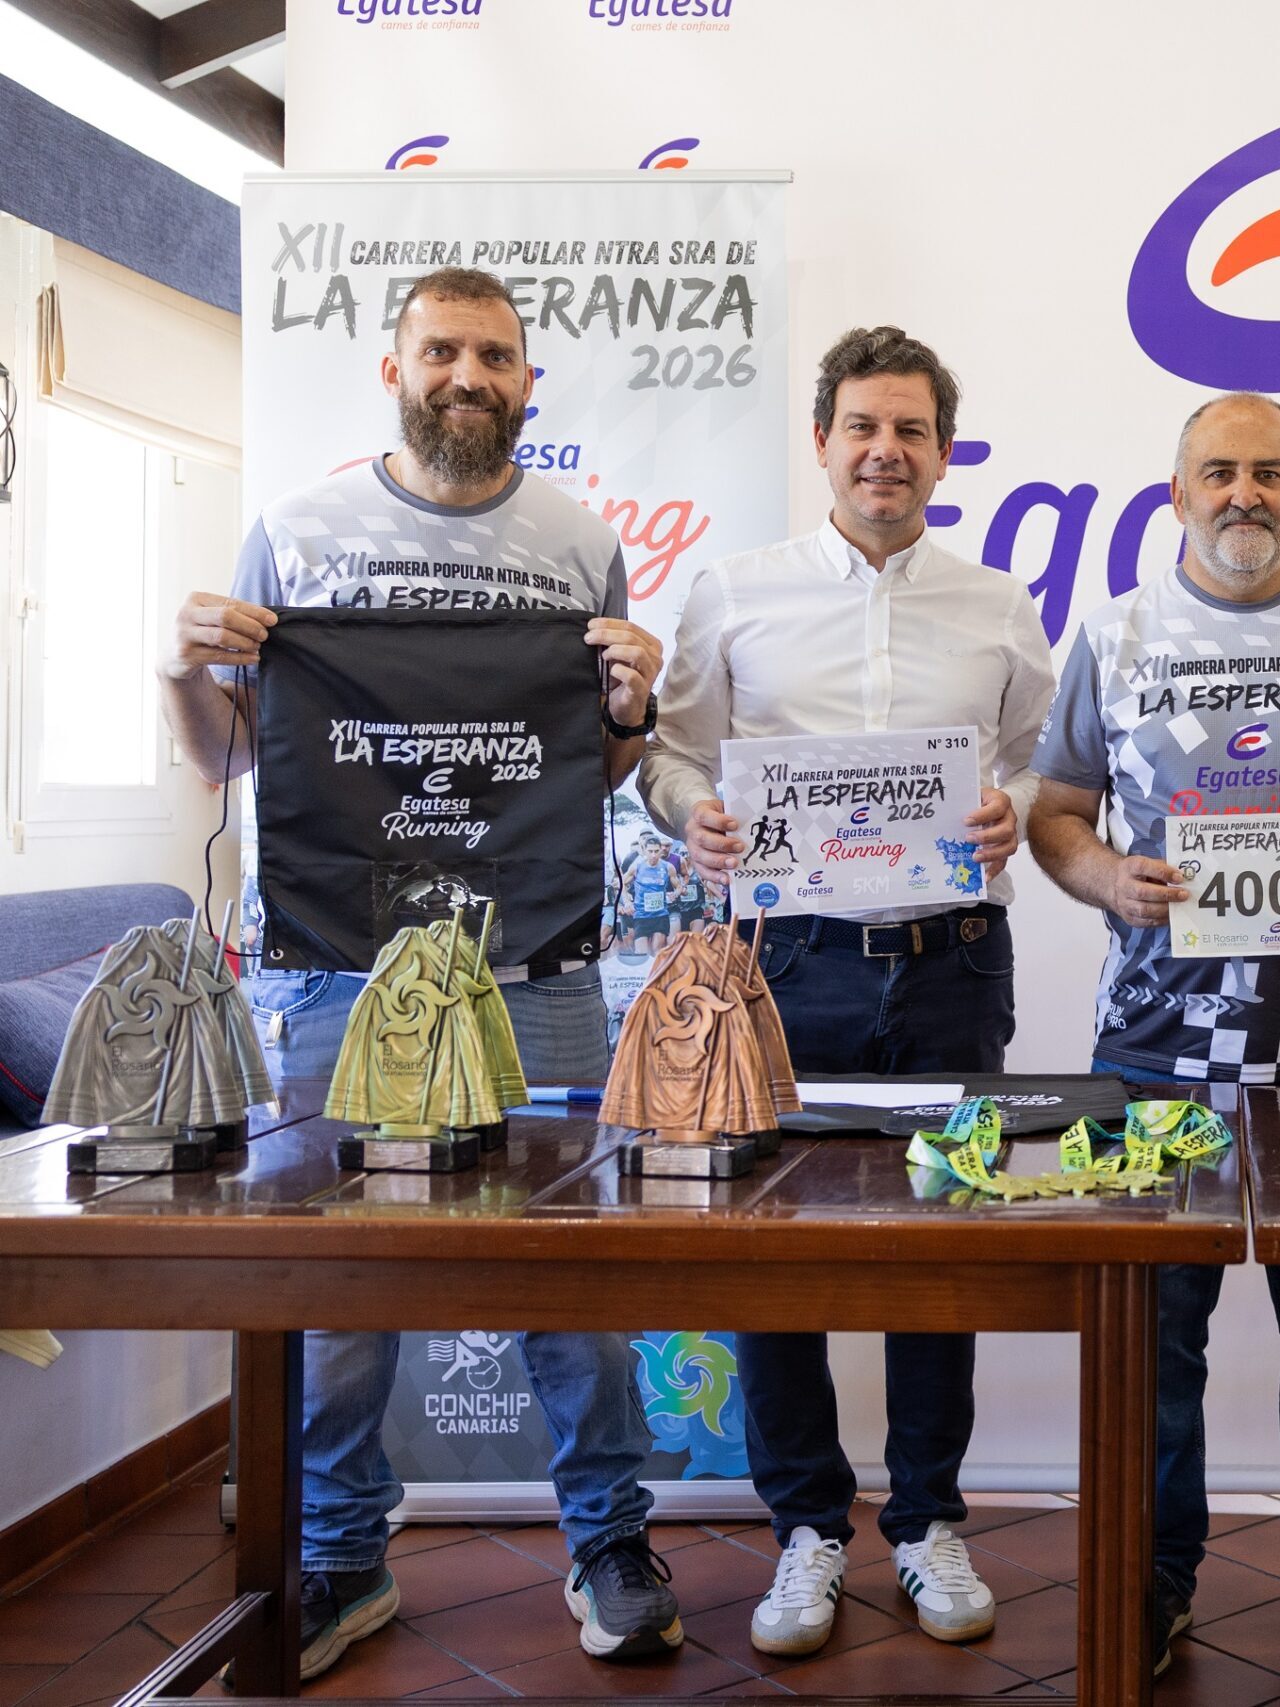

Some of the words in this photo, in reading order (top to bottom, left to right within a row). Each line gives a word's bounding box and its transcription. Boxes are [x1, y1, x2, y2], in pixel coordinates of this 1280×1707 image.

[416, 20, 428, 30] de
[665, 21, 677, 31] de
[271, 222, 345, 274] XII
[350, 240, 462, 265] CARRERA
[472, 240, 586, 265] POPULAR
[594, 240, 660, 265] NTRA
[668, 240, 716, 265] SRA
[725, 239, 757, 265] DE
[271, 274, 361, 340] LA
[381, 274, 759, 340] EERANZA
[627, 344, 757, 391] 2026
[321, 551, 368, 581] XII
[368, 561, 430, 577] CARRERA
[433, 562, 494, 582] POPULAR
[497, 567, 530, 587] NTRA
[532, 573, 556, 593] SRA
[558, 580, 572, 597] DE
[330, 586, 375, 609] LA
[1129, 653, 1170, 684] XII
[1170, 659, 1226, 677] CARRERA
[1138, 688, 1185, 718] LA
[328, 719, 361, 742] XII
[363, 722, 409, 735] CARRERA
[411, 722, 459, 735] POPULAR
[460, 722, 488, 735] NTRA
[490, 721, 510, 734] SRA
[512, 721, 526, 733] DE
[334, 737, 375, 766] LA
[382, 735, 543, 766] ESPERANZA
[945, 737, 969, 749] 310
[491, 762, 541, 782] 2026
[761, 763, 788, 784] XII
[791, 770, 834, 783] CARRERA
[836, 767, 880, 780] POPULAR
[882, 765, 907, 777] NTRA
[910, 764, 928, 776] SRA
[930, 764, 943, 775] DE
[766, 785, 799, 810] LA
[807, 777, 947, 807] ESPERANZA
[400, 795, 471, 816] Egatesa
[887, 802, 936, 823] 2026
[381, 811, 491, 849] Running
[836, 826, 882, 841] Egatesa
[1177, 821, 1198, 838] XII
[1199, 822, 1229, 832] CARRERA
[1230, 821, 1260, 831] POPULAR
[1262, 820, 1279, 830] NTRA
[820, 839, 907, 867] Running
[1181, 834, 1206, 853] LA
[797, 885, 834, 898] Egatesa
[852, 874, 890, 896] 5KM
[1202, 934, 1211, 943] El
[1213, 933, 1249, 943] Rosario
[1183, 1120, 1231, 1151] ESPERA
[425, 1392, 531, 1417] CONCHIP
[435, 1418, 520, 1435] CANARIAS
